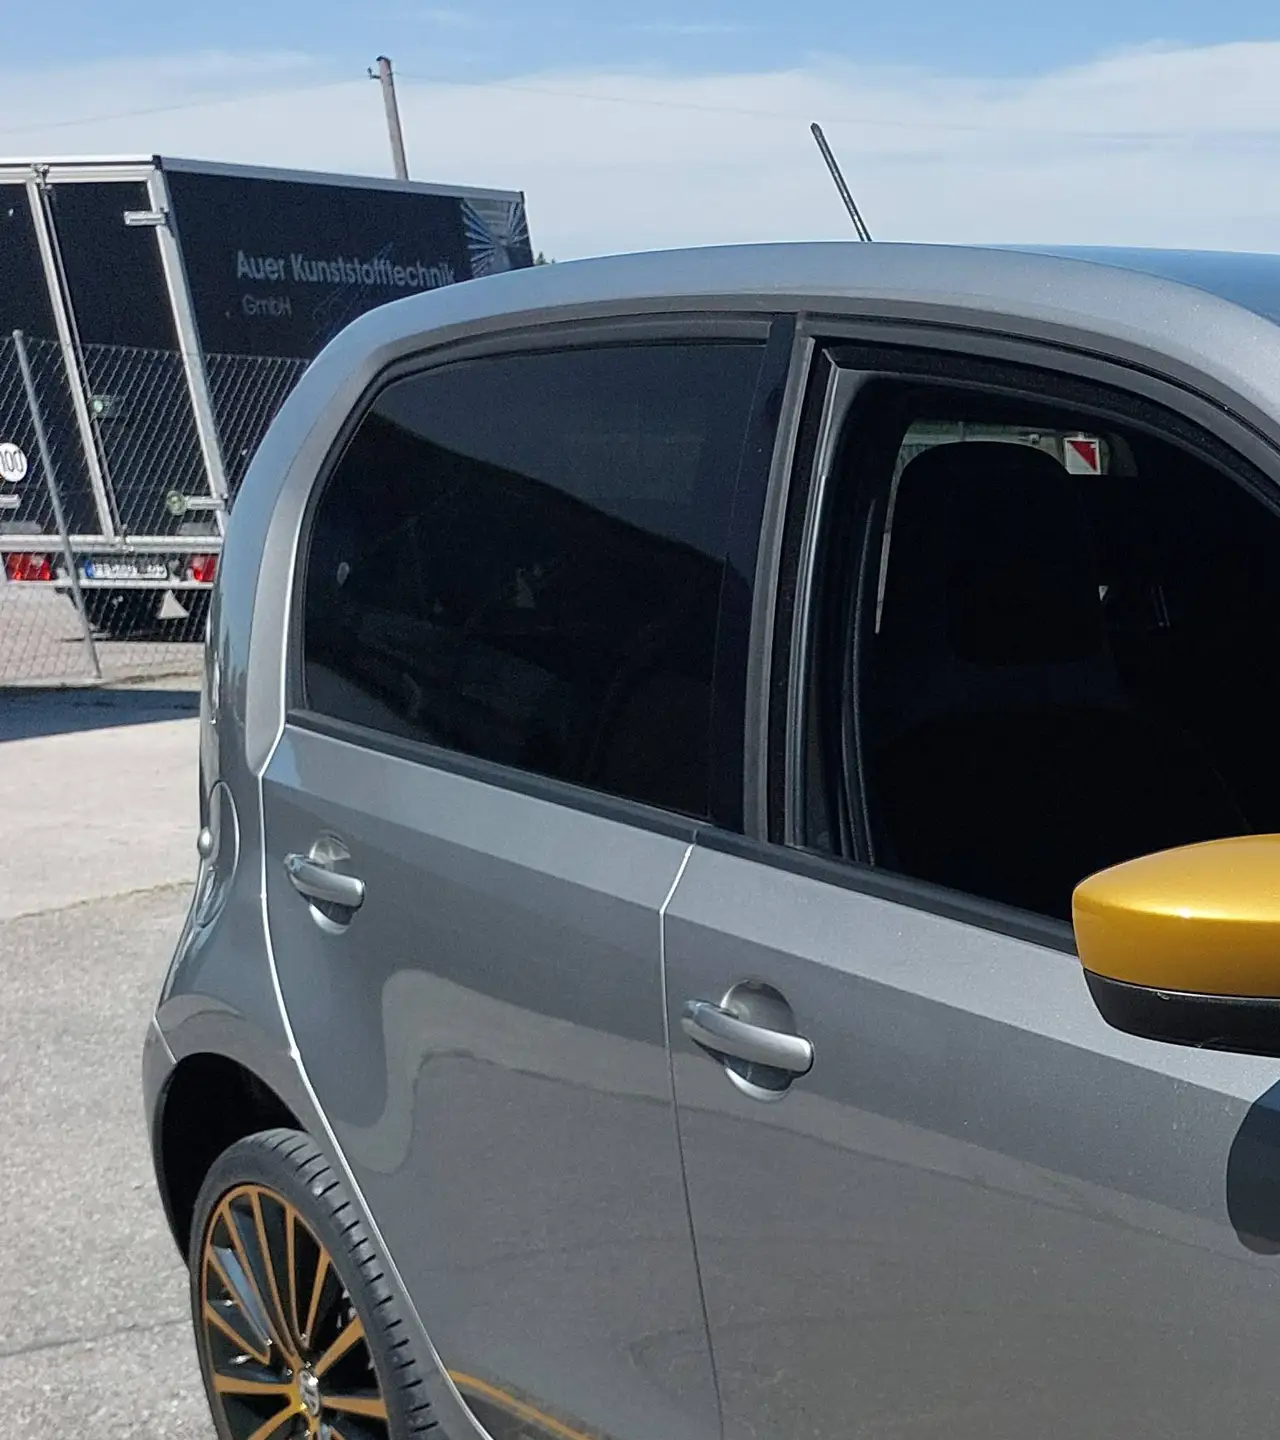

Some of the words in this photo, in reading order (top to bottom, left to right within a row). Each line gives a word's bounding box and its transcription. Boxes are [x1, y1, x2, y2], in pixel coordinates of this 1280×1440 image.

[237, 251, 286, 281] Auer
[291, 252, 455, 288] Kunststofftechnik
[241, 294, 292, 317] GmbH
